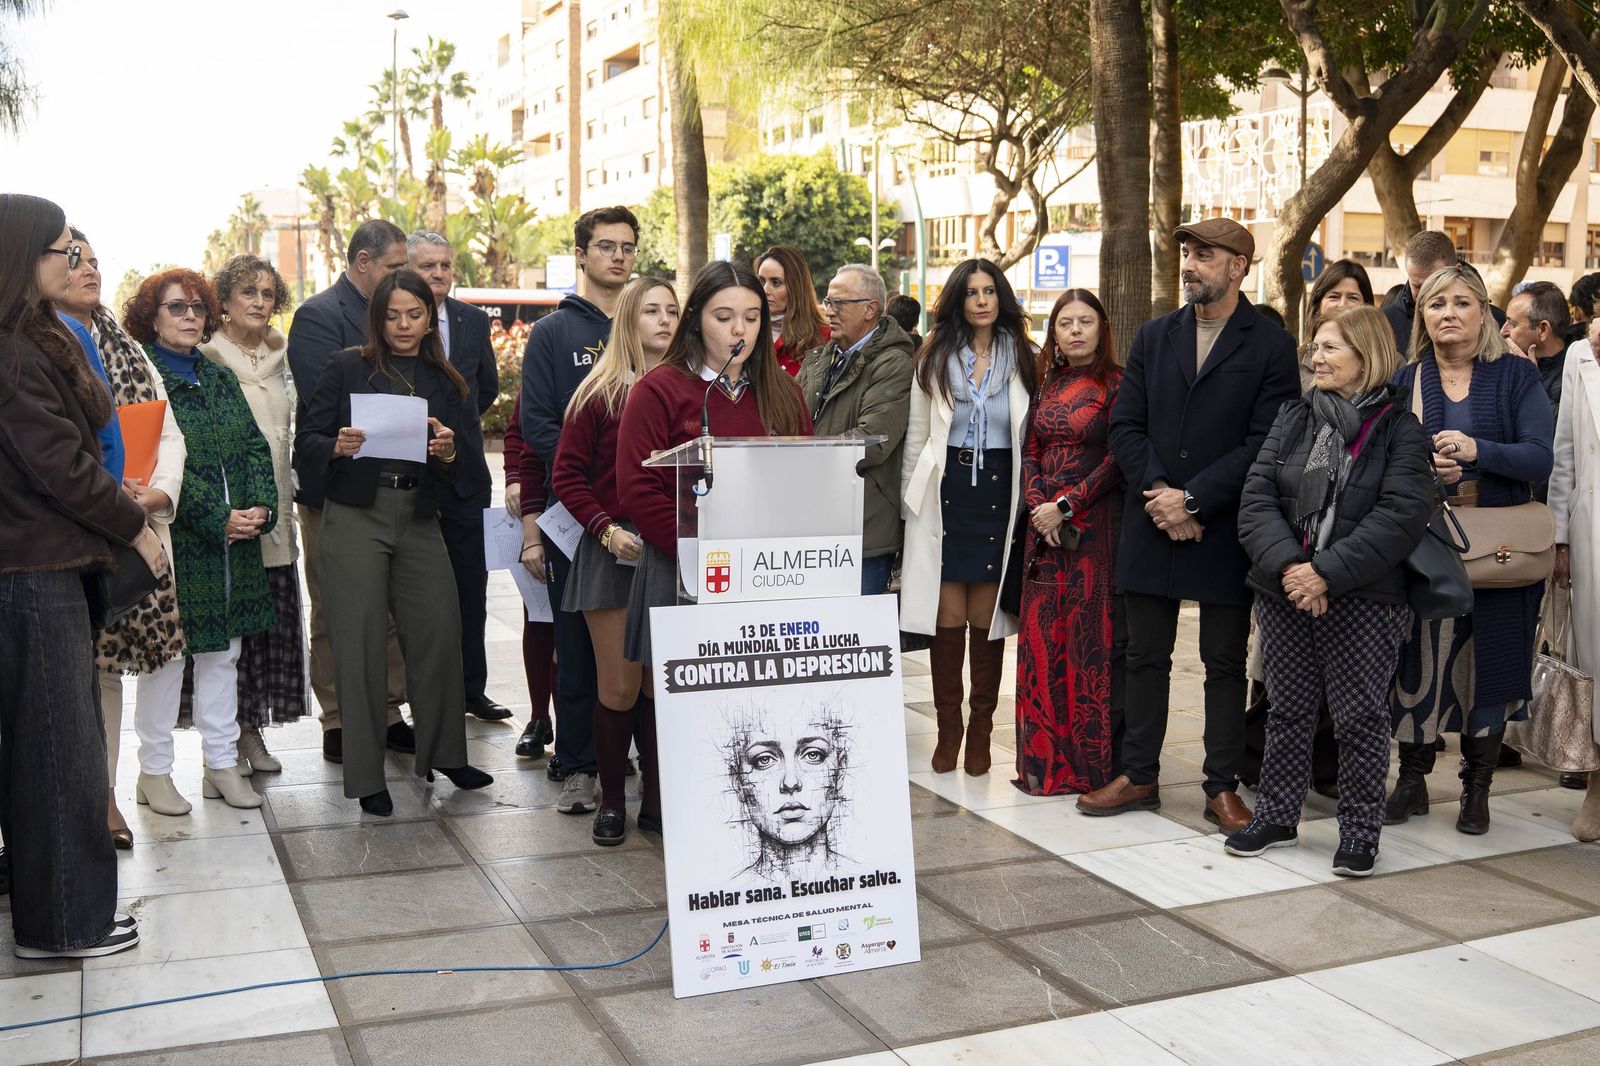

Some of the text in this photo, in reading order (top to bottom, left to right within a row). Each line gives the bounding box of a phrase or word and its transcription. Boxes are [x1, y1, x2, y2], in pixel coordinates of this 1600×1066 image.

[1039, 249, 1059, 275] P
[572, 352, 593, 367] La
[753, 544, 854, 571] ALMERÍA
[752, 573, 805, 588] CIUDAD
[739, 620, 820, 639] 13 DE ENERO
[698, 633, 860, 657] DÍA MUNDIAL DE LA LUCHA
[674, 649, 885, 687] CONTRA LA DEPRESIÓN
[688, 869, 902, 912] Hablar sana. Escuchar salva.
[722, 917, 749, 928] MESA
[750, 913, 789, 926] TÉCNICA
[805, 907, 835, 918] SALUD
[835, 902, 874, 914] MENTAL
[860, 940, 886, 950] Asperger
